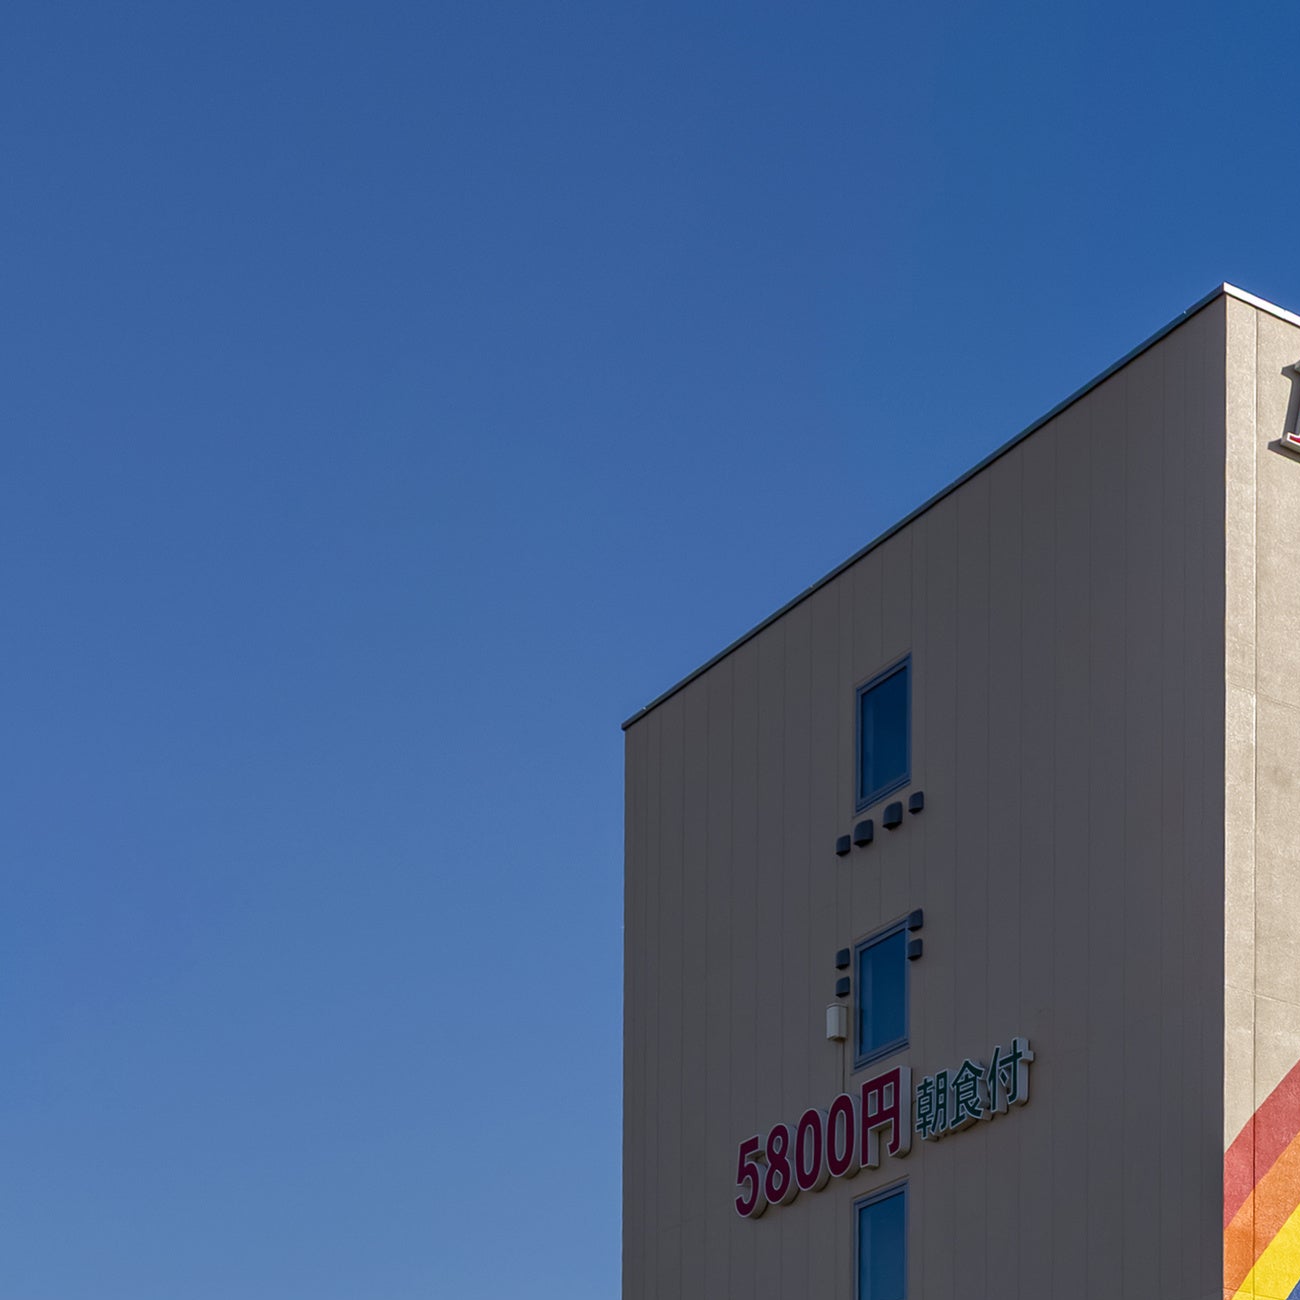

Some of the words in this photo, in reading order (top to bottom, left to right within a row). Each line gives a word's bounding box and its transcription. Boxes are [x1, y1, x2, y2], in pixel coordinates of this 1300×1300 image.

[735, 1065, 904, 1218] 5800円
[915, 1038, 1026, 1141] 朝食付
